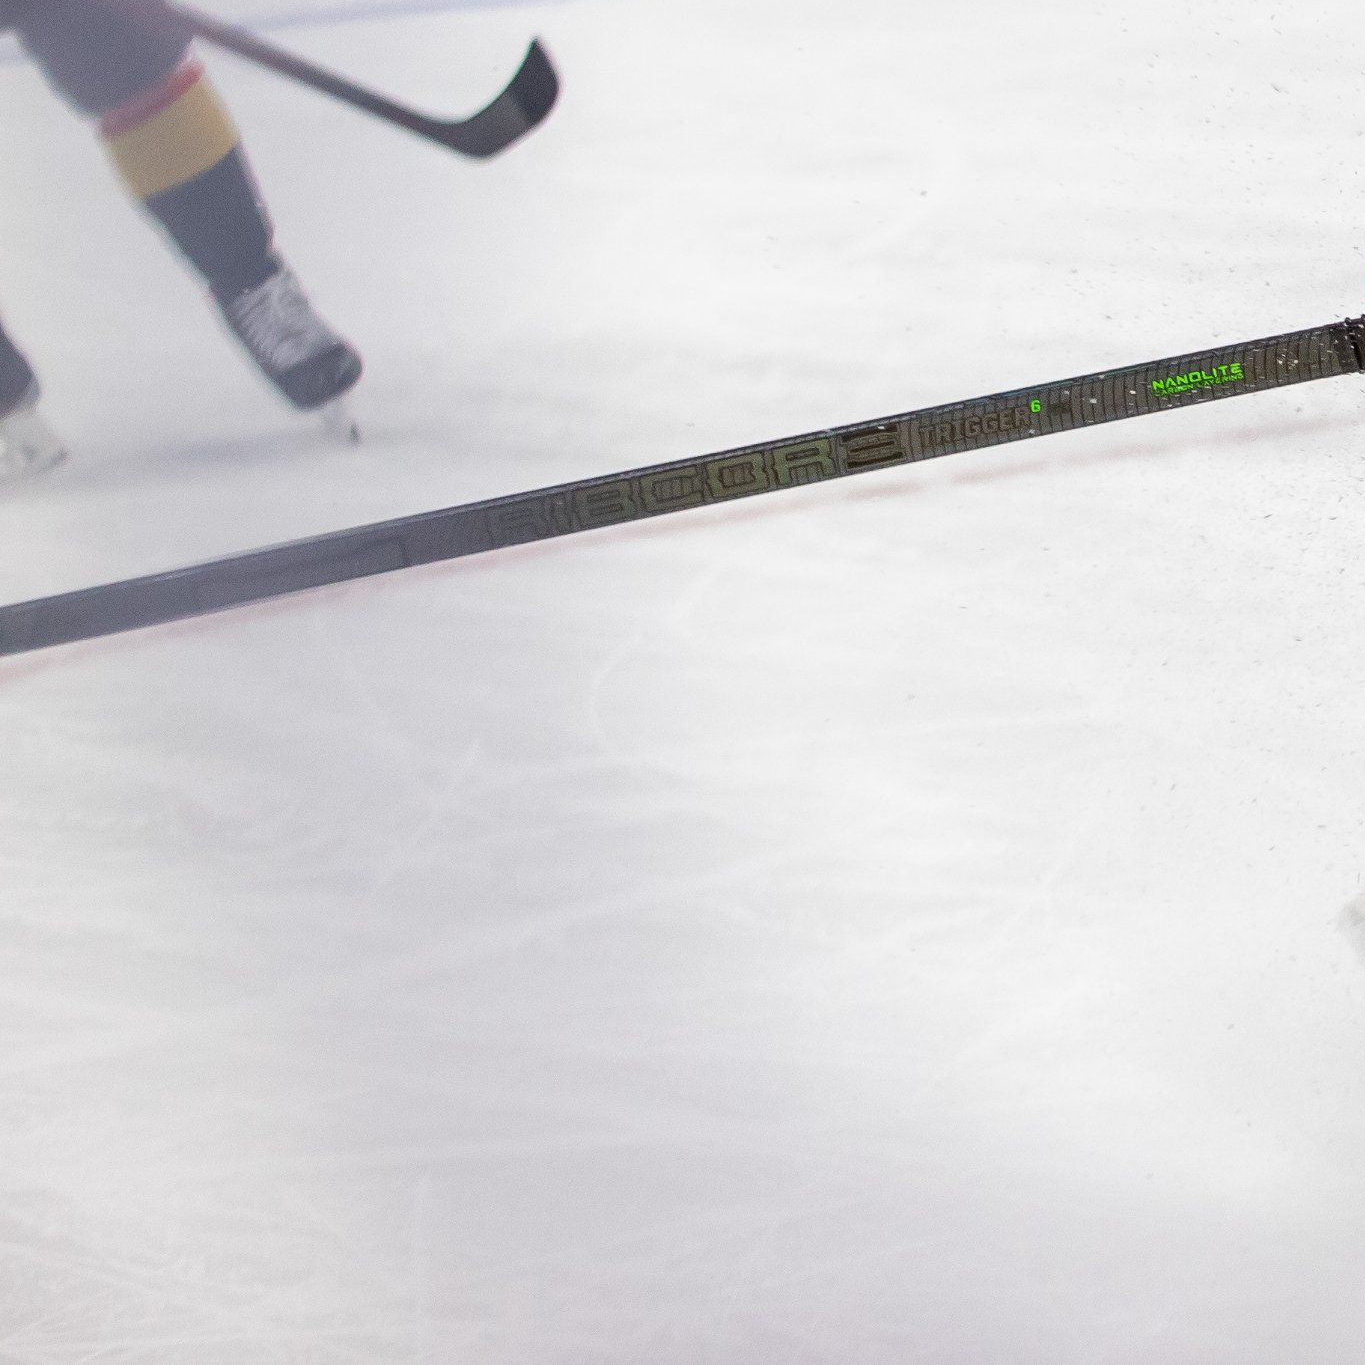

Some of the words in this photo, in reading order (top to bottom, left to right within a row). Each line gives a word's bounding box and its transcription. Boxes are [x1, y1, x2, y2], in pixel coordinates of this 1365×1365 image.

[1152, 362, 1242, 391] NANOLITE
[918, 404, 1030, 449] TRIGGER
[1030, 398, 1041, 414] 6
